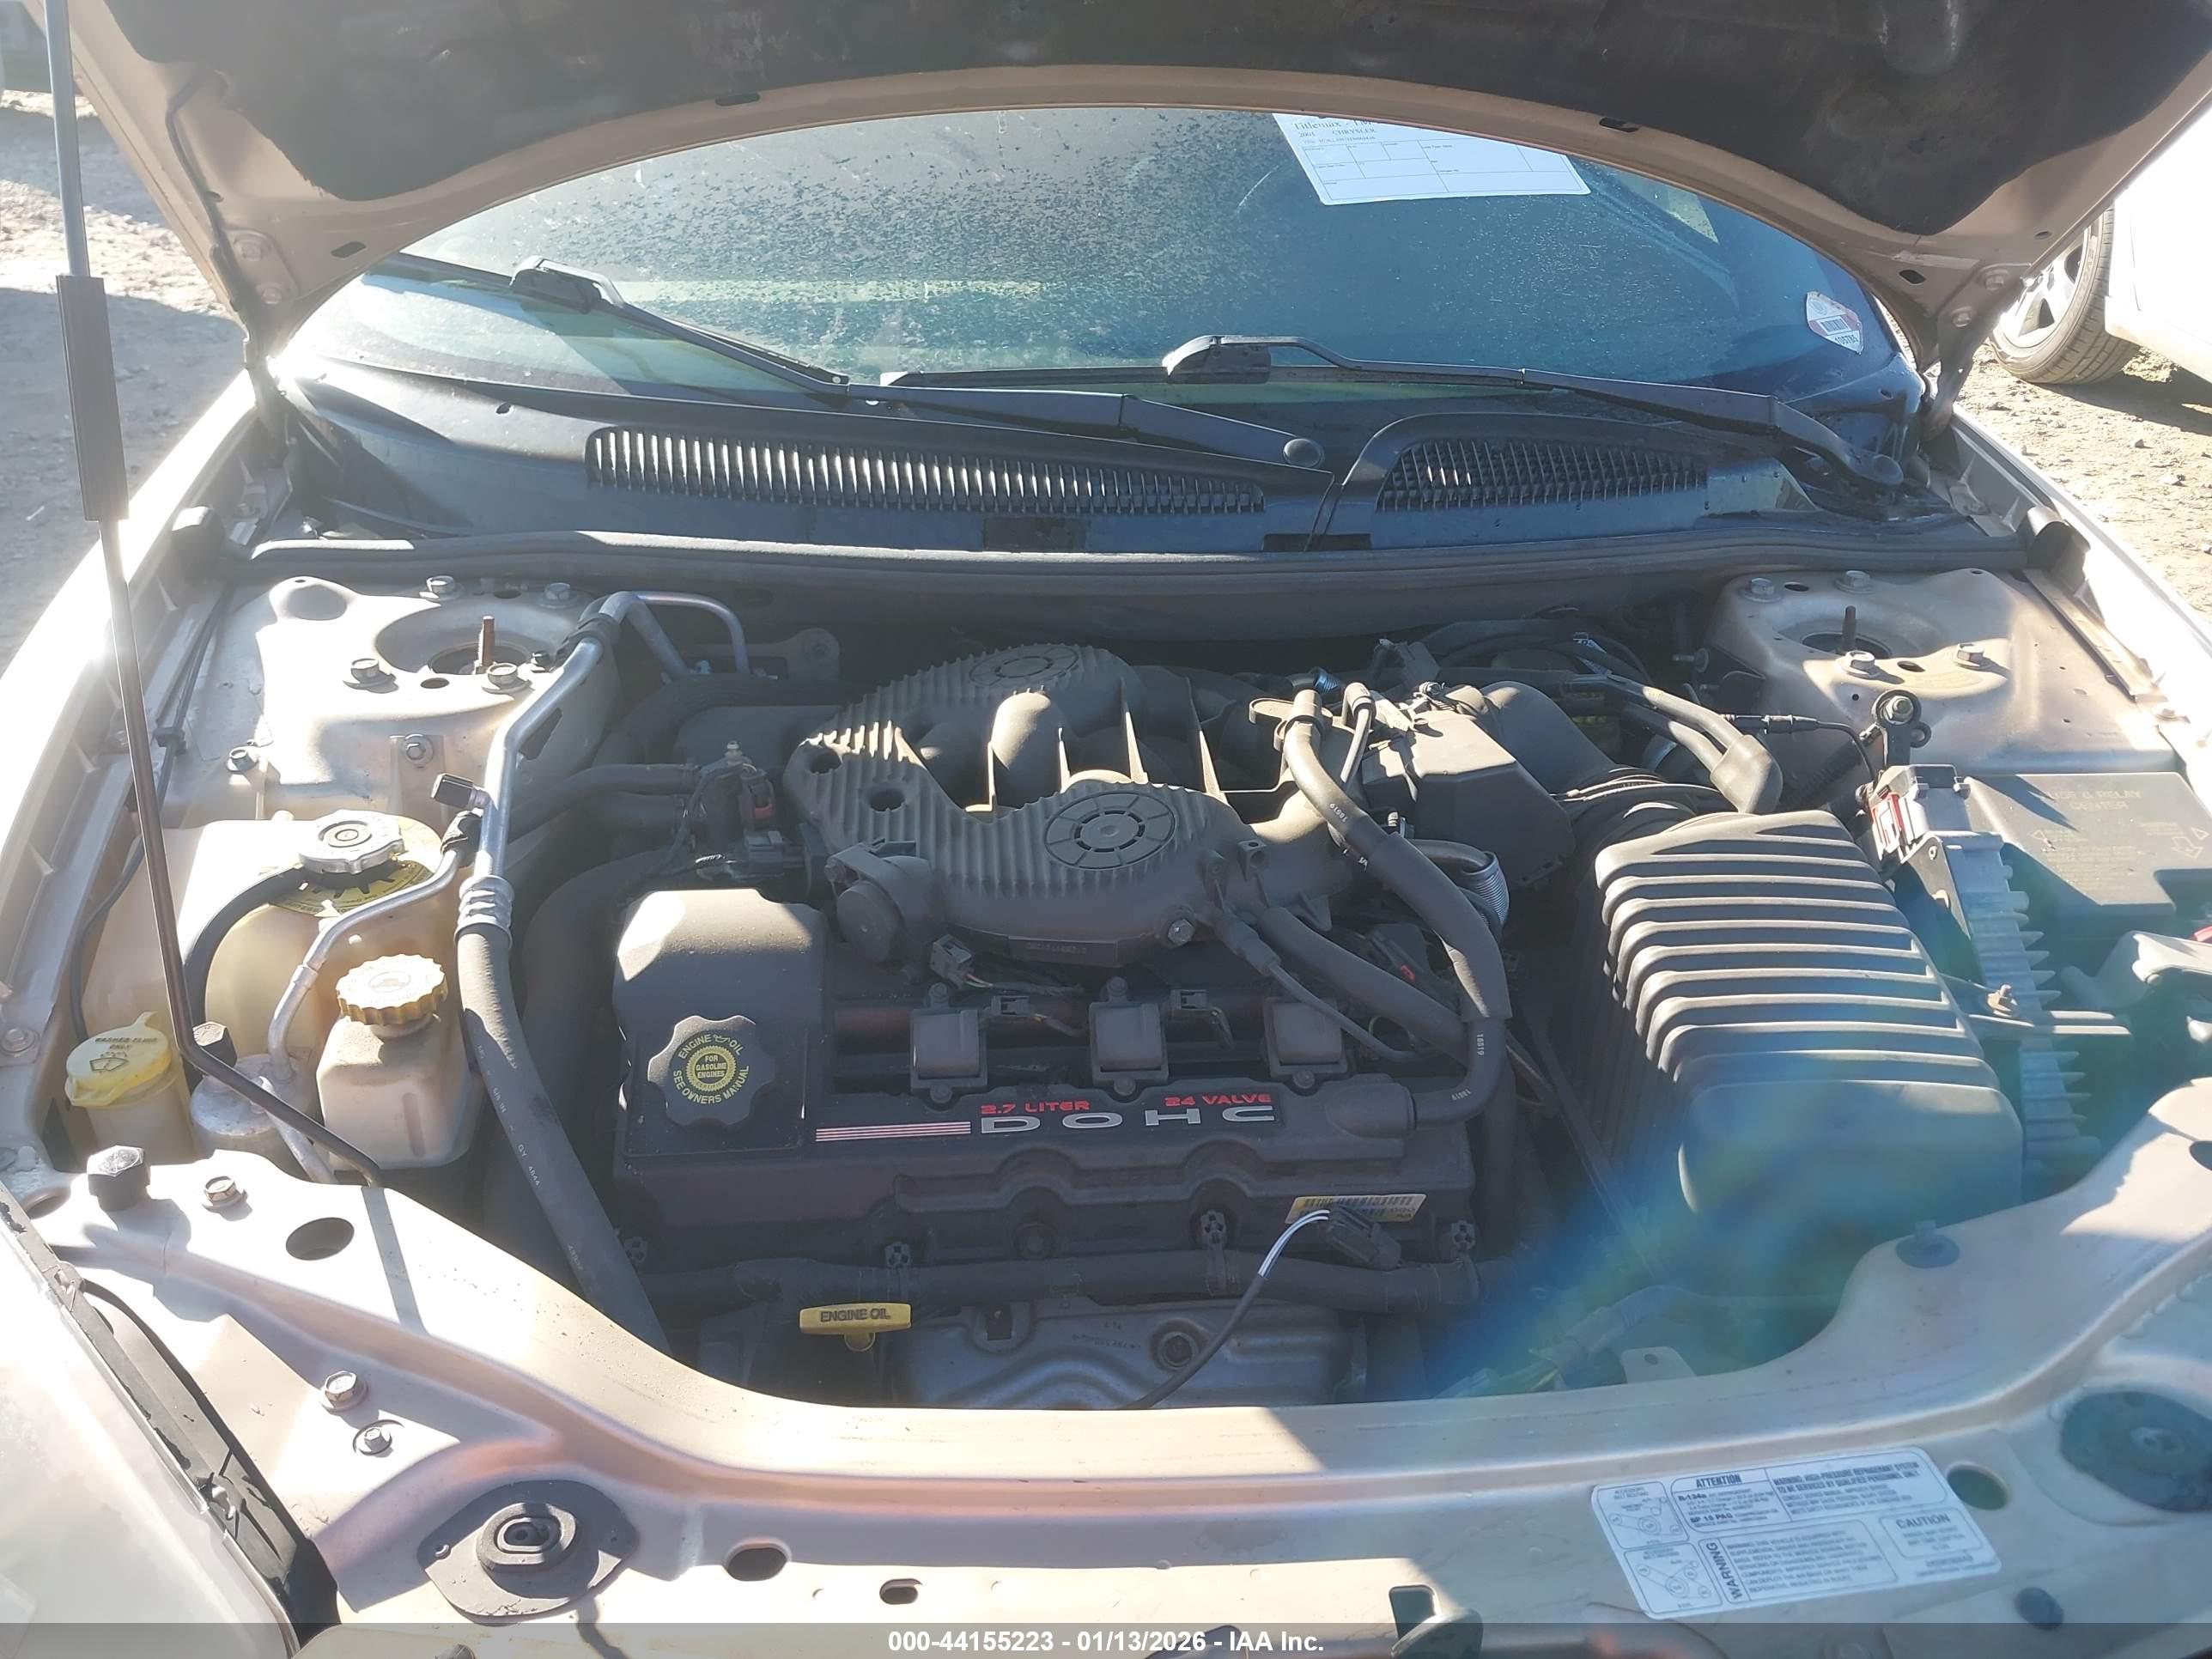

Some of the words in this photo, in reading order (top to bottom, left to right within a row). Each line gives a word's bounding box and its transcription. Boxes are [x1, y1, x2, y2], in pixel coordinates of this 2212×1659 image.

[678, 1033, 712, 1059] ENGINE
[729, 1039, 744, 1055] OIL
[704, 1054, 719, 1063] FOR
[696, 1062, 727, 1071] GASOLINE
[673, 1070, 686, 1090] SEE
[682, 1087, 722, 1103] OWNERS
[722, 1065, 749, 1099] MANUAL
[1164, 1097, 1196, 1107] 24
[1201, 1093, 1272, 1105] VALVE
[981, 1103, 1017, 1115] 2.7
[1024, 1100, 1091, 1113] LITER
[820, 1308, 867, 1322] ENGINE
[869, 1308, 891, 1321] OIL
[1695, 1474, 1742, 1488] ATTENTION
[1895, 1512, 1951, 1529] CAUTION
[1705, 1541, 1743, 1600] WARNING
